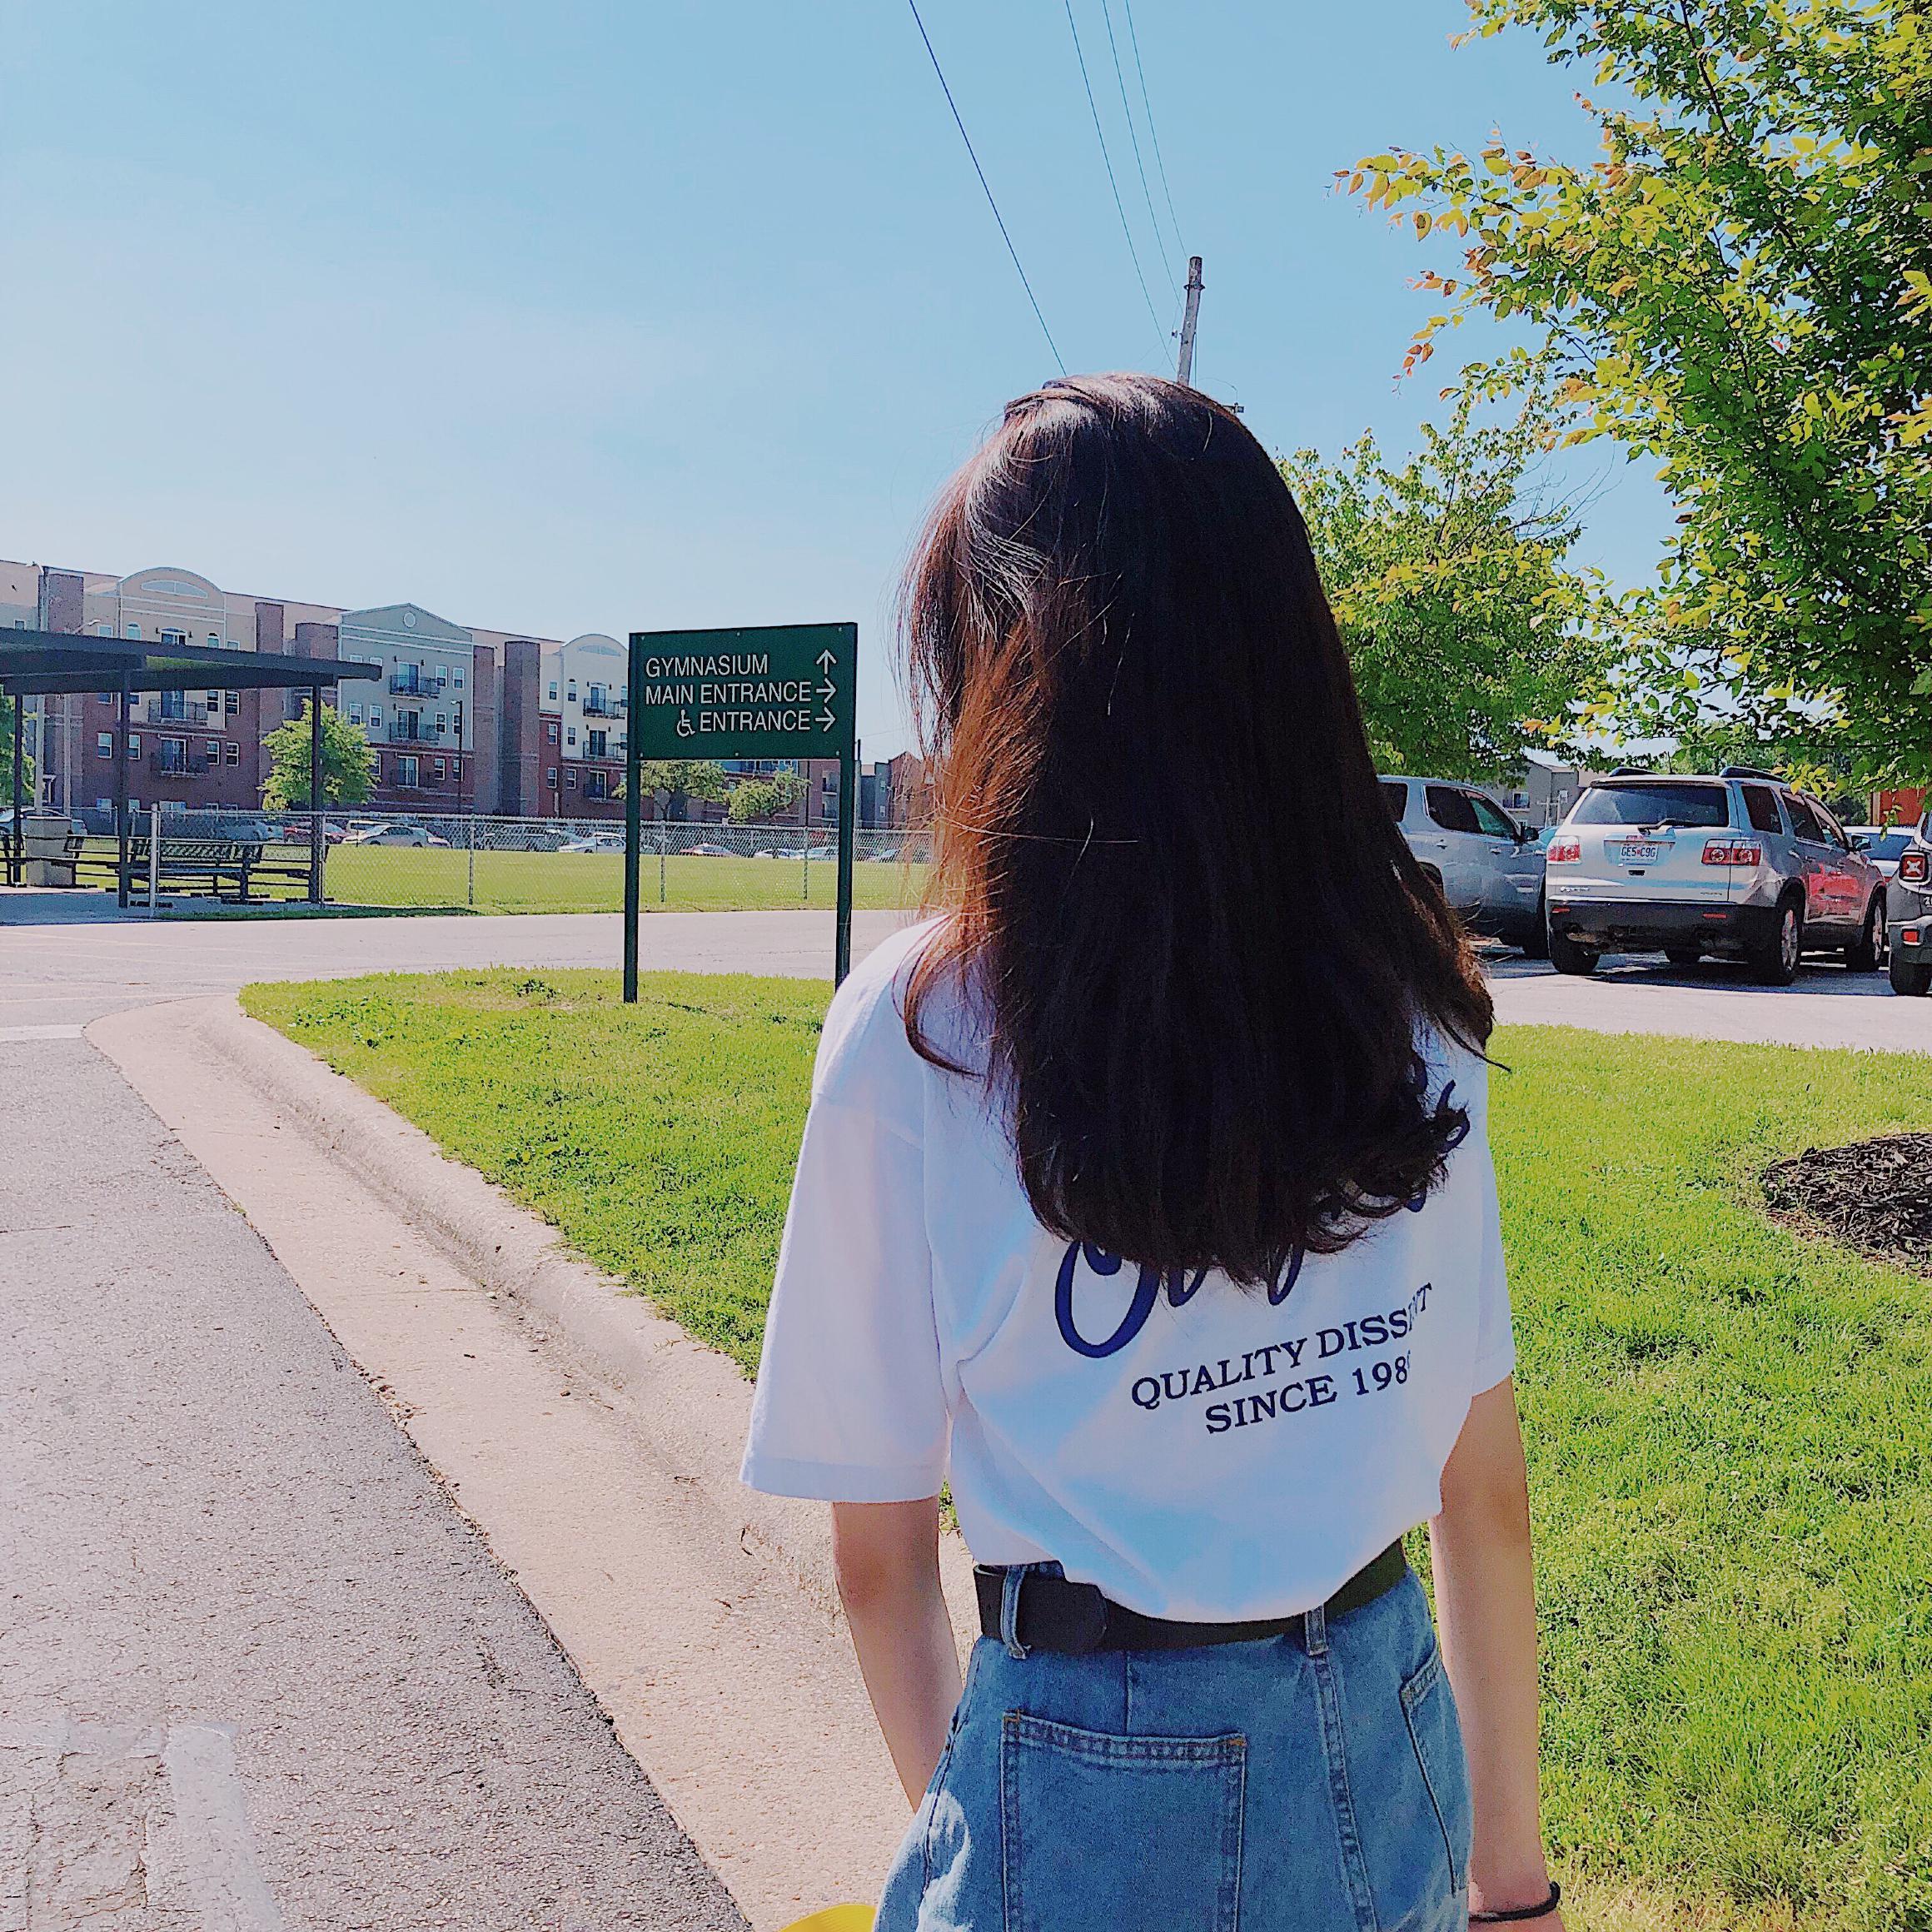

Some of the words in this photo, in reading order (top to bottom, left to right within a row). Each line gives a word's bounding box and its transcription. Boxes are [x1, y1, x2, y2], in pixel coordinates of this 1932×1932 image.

[645, 654, 769, 678] GYMNASIUM
[645, 684, 694, 705] MAIN
[700, 681, 812, 704] ENTRANCE
[700, 710, 811, 732] ENTRANCE
[1131, 1337, 1308, 1410] QUALITY
[1315, 1282, 1432, 1359] DISST
[1205, 1374, 1338, 1434] SINCE
[1352, 1349, 1412, 1397] 198
